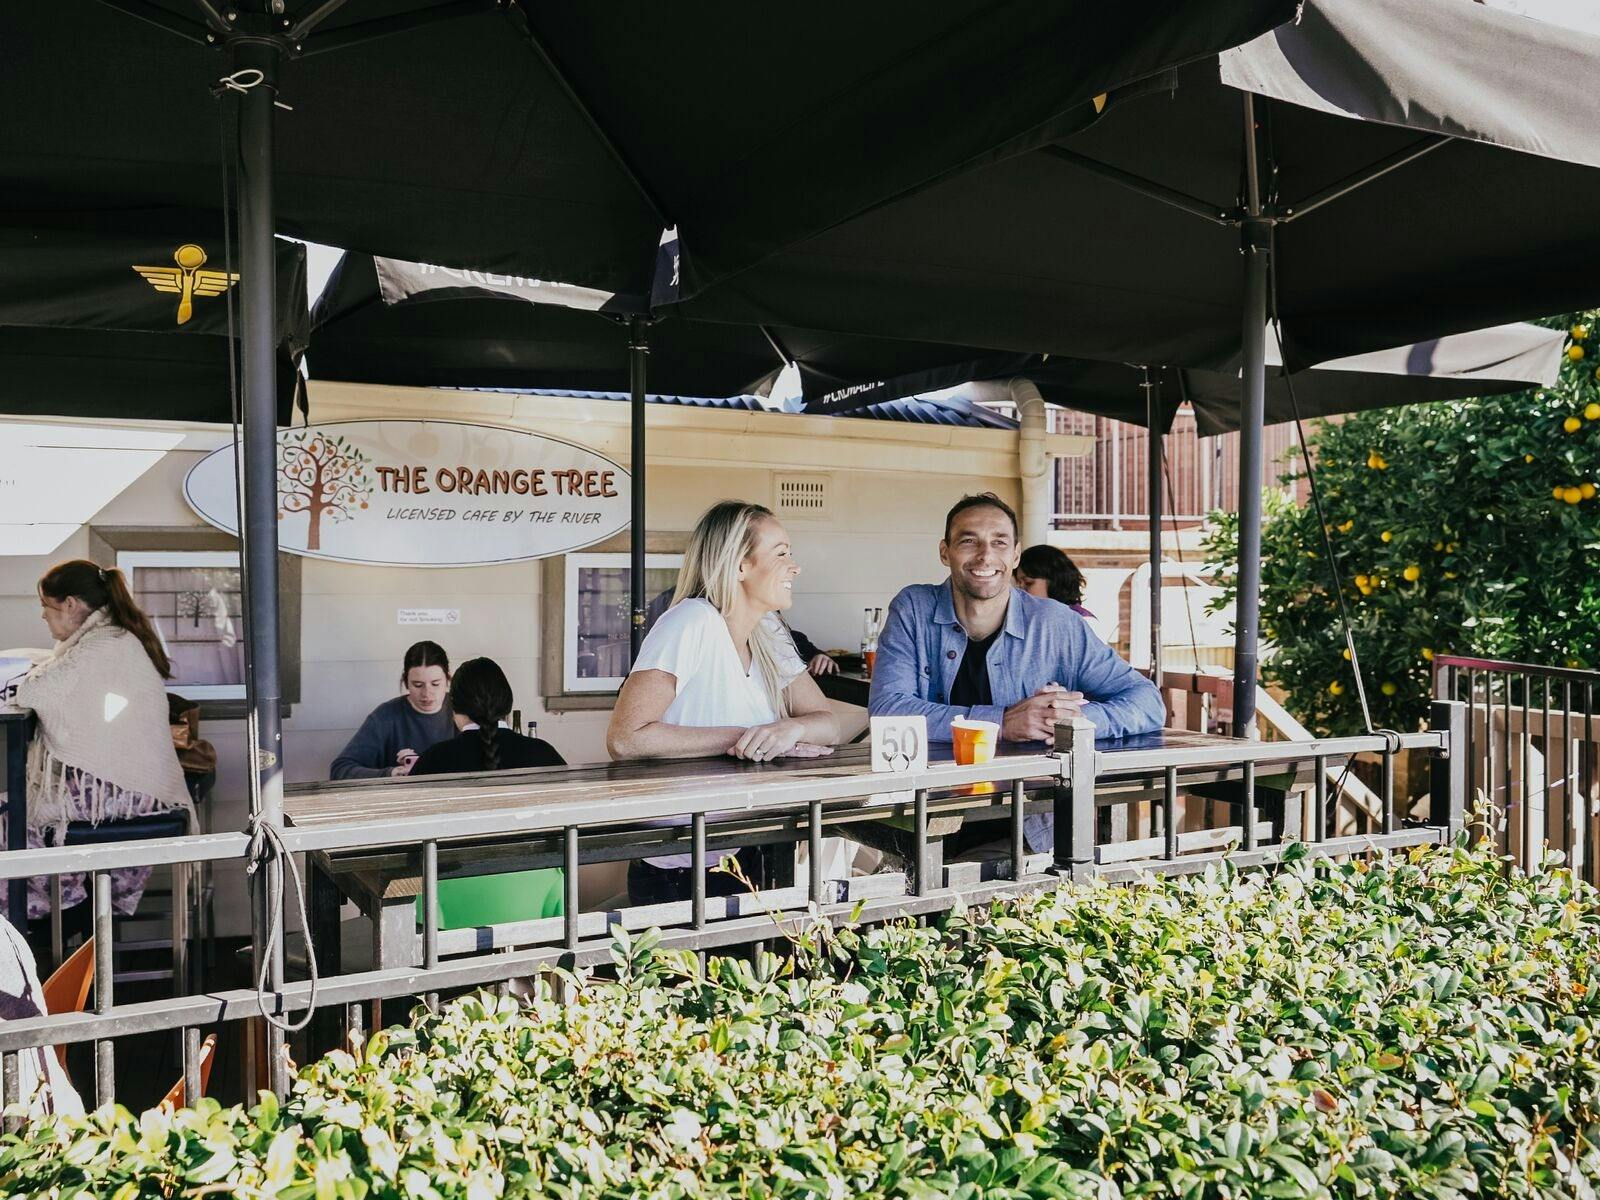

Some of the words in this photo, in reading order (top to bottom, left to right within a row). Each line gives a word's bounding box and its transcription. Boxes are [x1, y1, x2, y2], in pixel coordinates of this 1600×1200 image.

[375, 465, 430, 494] THE
[435, 466, 548, 496] ORANGE
[551, 469, 618, 498] TREE
[387, 507, 457, 521] LICENSED
[462, 509, 499, 522] CAFE
[502, 510, 524, 523] BY
[529, 510, 557, 523] THE
[561, 511, 602, 524] RIVER
[882, 726, 919, 761] 50
